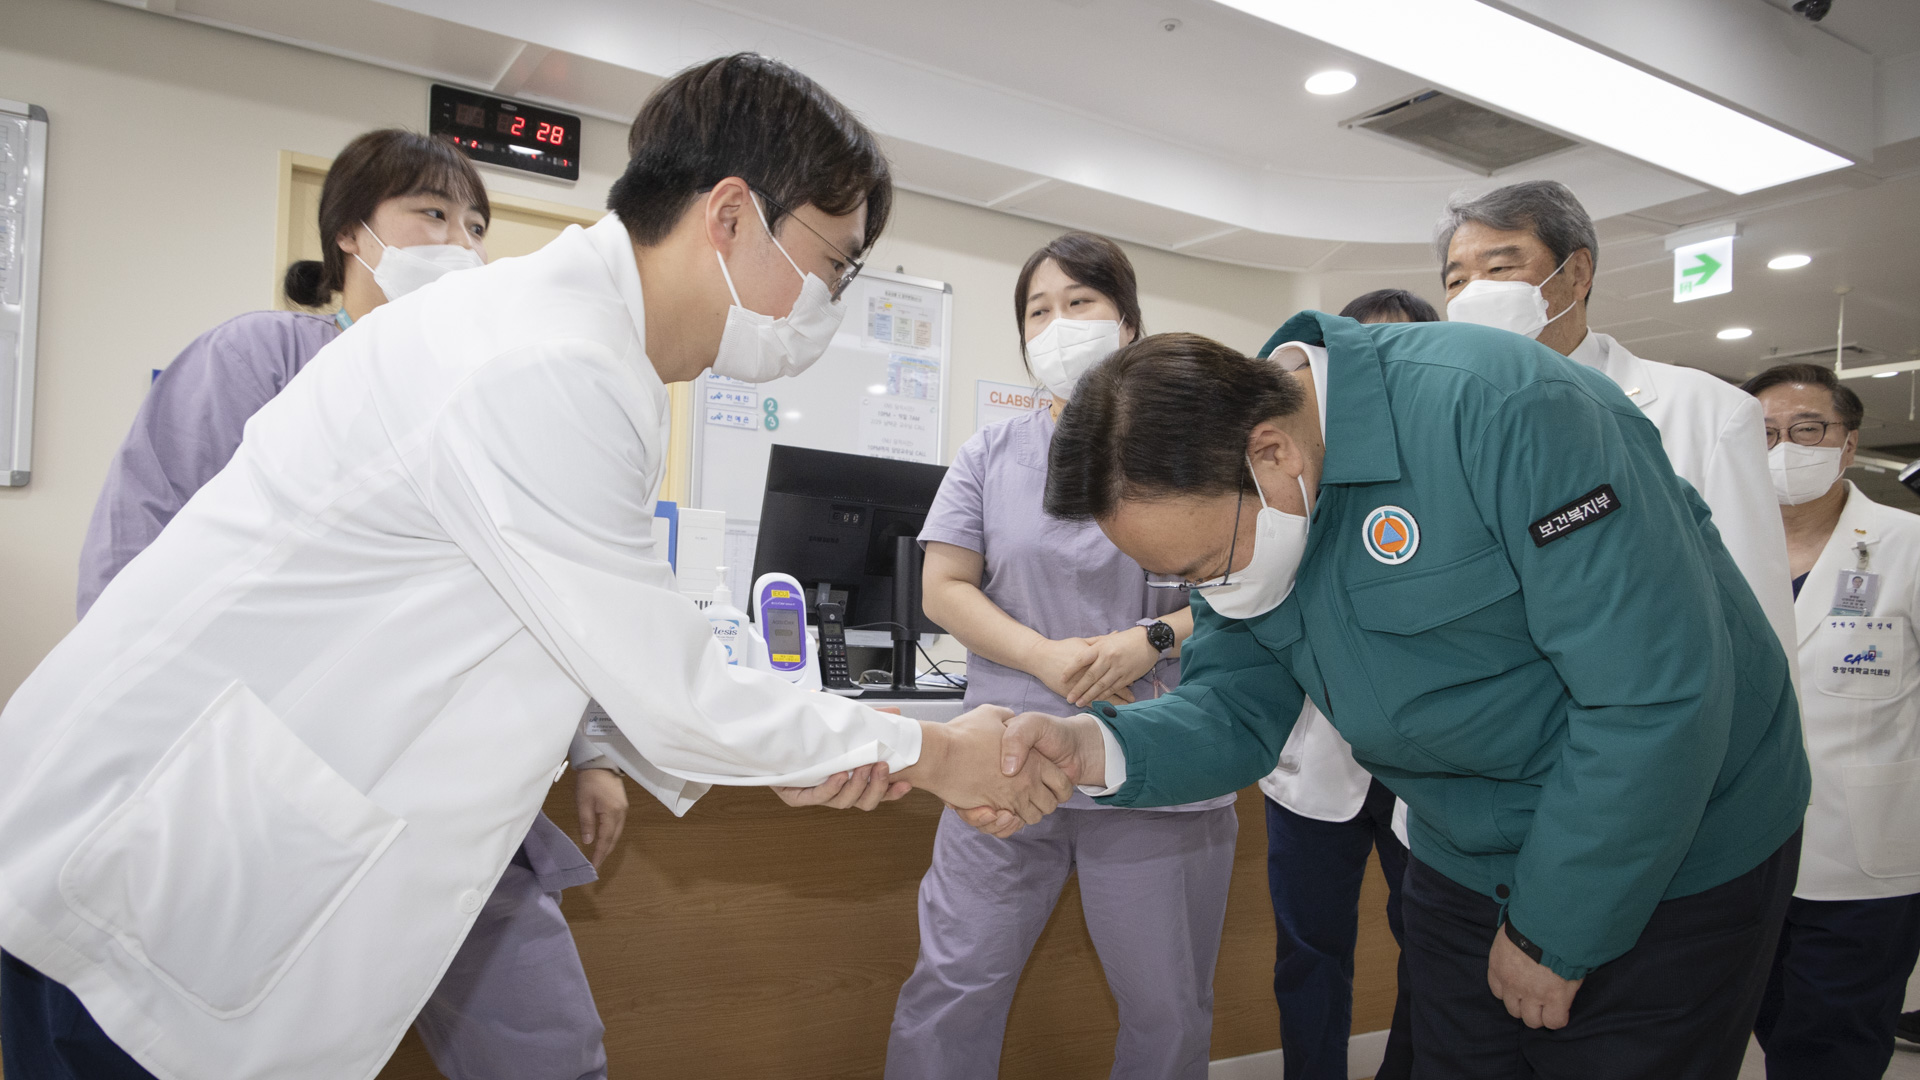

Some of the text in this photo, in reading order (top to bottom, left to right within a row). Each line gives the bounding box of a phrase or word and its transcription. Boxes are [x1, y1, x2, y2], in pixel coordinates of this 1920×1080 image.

[511, 116, 565, 146] 2 28
[767, 400, 776, 411] 2
[989, 391, 1035, 409] CLABSI
[767, 416, 776, 427] 3
[1538, 492, 1611, 538] 보건복지부
[1832, 666, 1891, 677] 중앙대학교의료원
